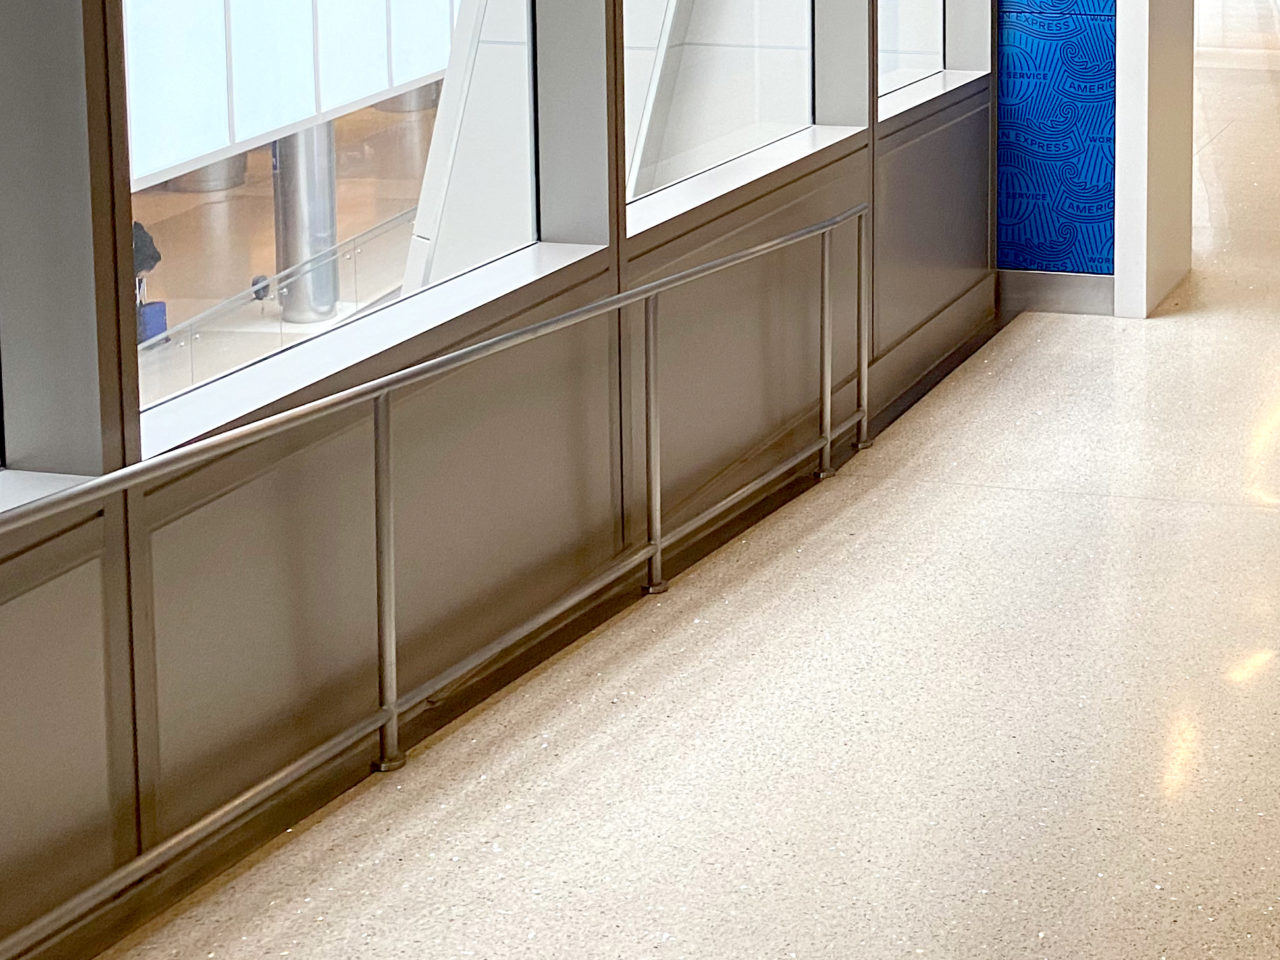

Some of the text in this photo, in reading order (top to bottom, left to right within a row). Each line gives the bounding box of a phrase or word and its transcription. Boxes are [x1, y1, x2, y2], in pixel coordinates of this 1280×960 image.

[1015, 13, 1071, 32] EXPRESS
[1006, 72, 1049, 81] SERVICE
[1014, 131, 1070, 153] EXPRESS
